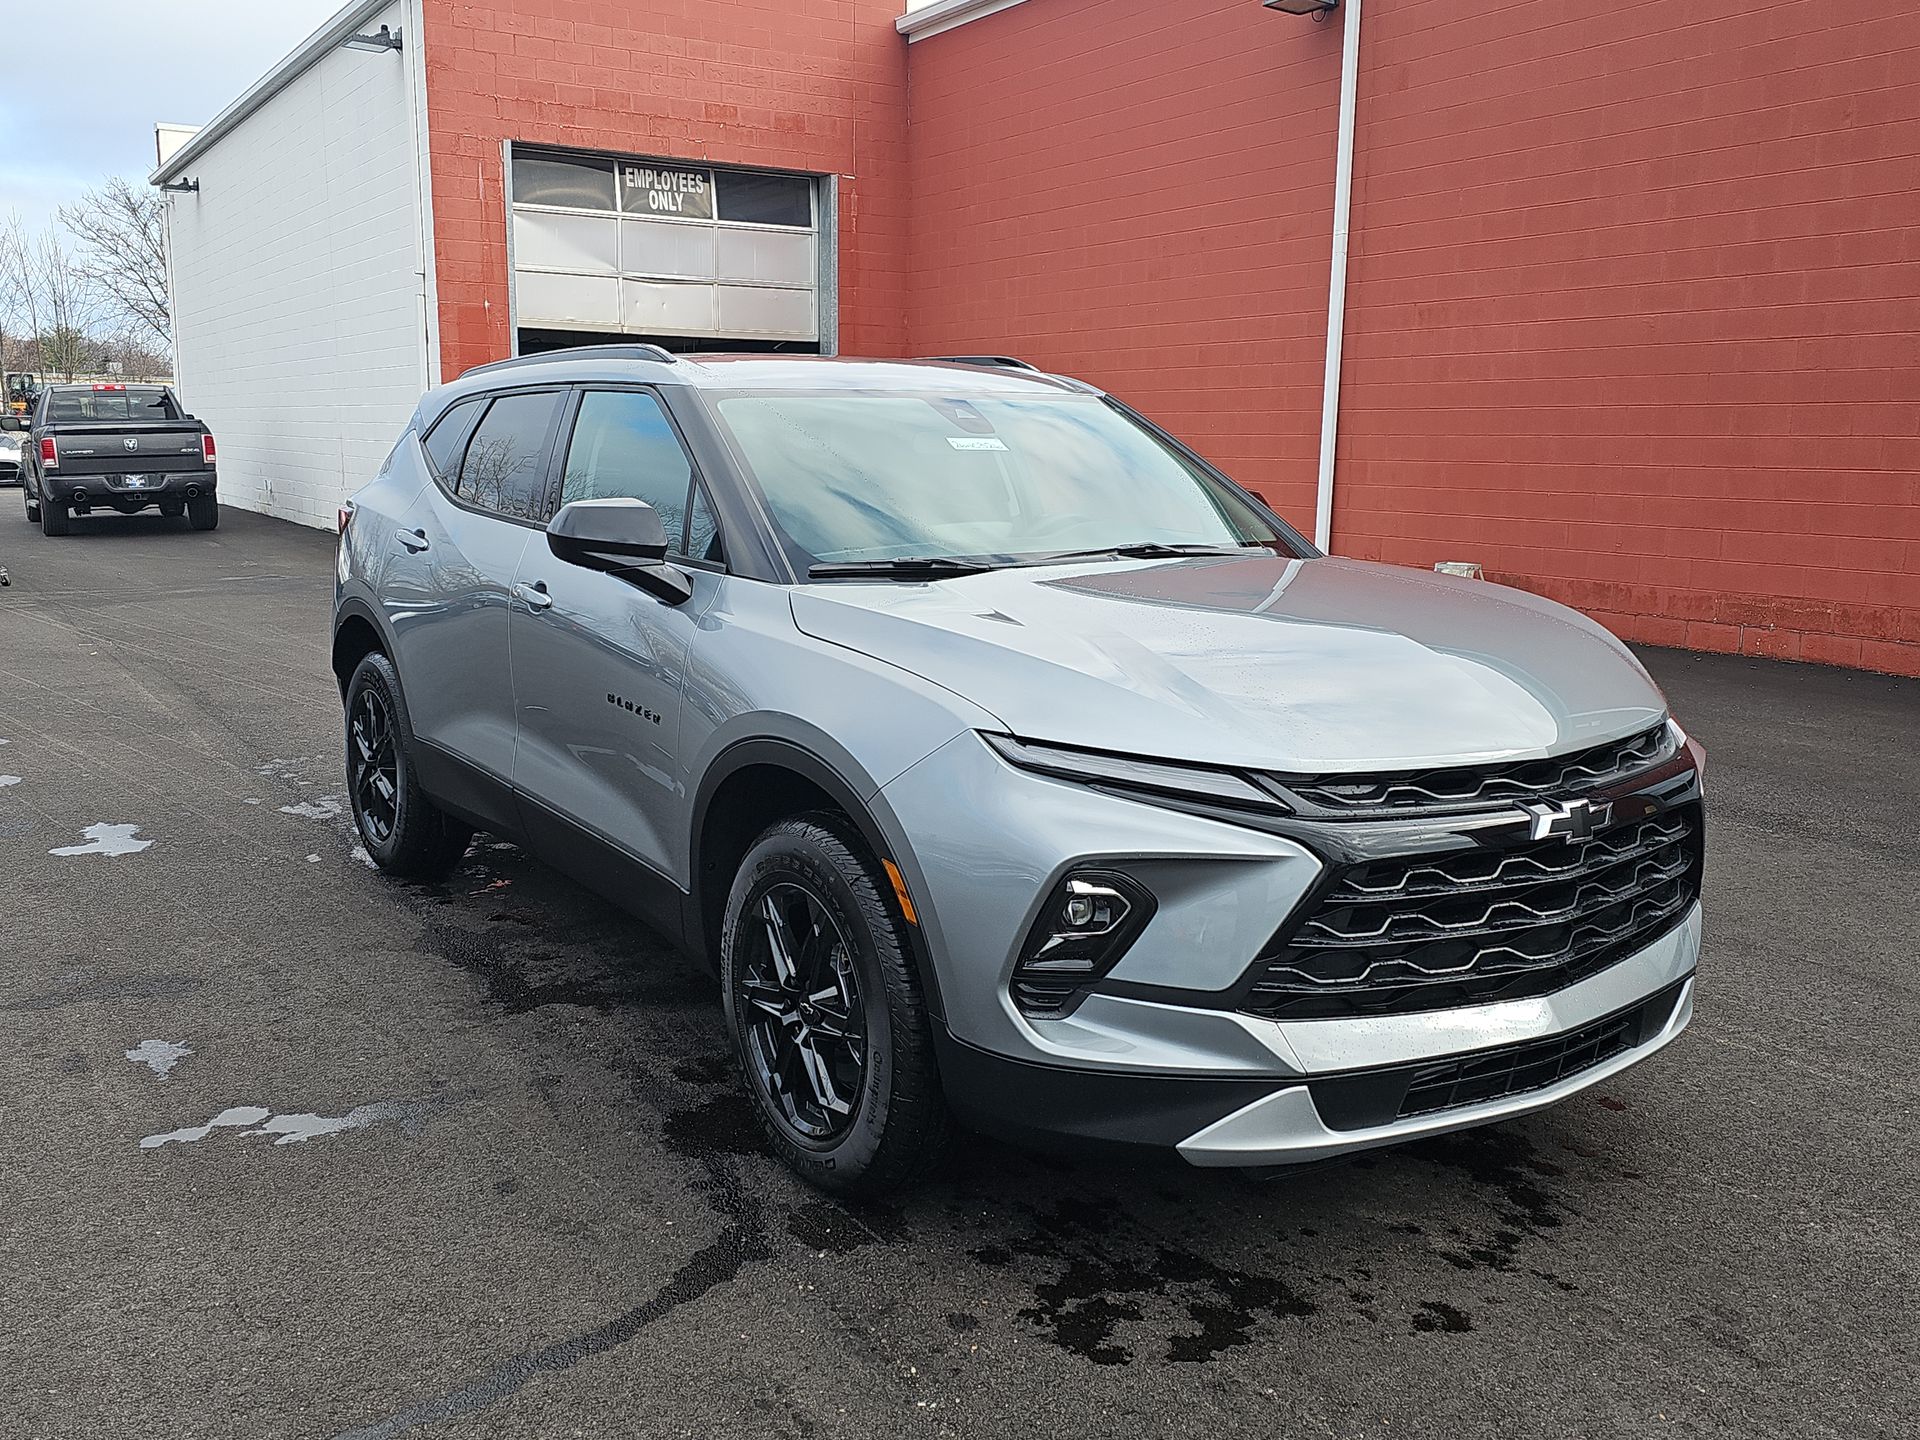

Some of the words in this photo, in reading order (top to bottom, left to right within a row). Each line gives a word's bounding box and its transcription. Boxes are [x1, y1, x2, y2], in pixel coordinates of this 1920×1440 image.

[625, 167, 704, 194] EMPLOYEES
[648, 190, 684, 212] ONLY
[607, 693, 661, 725] BLAZER
